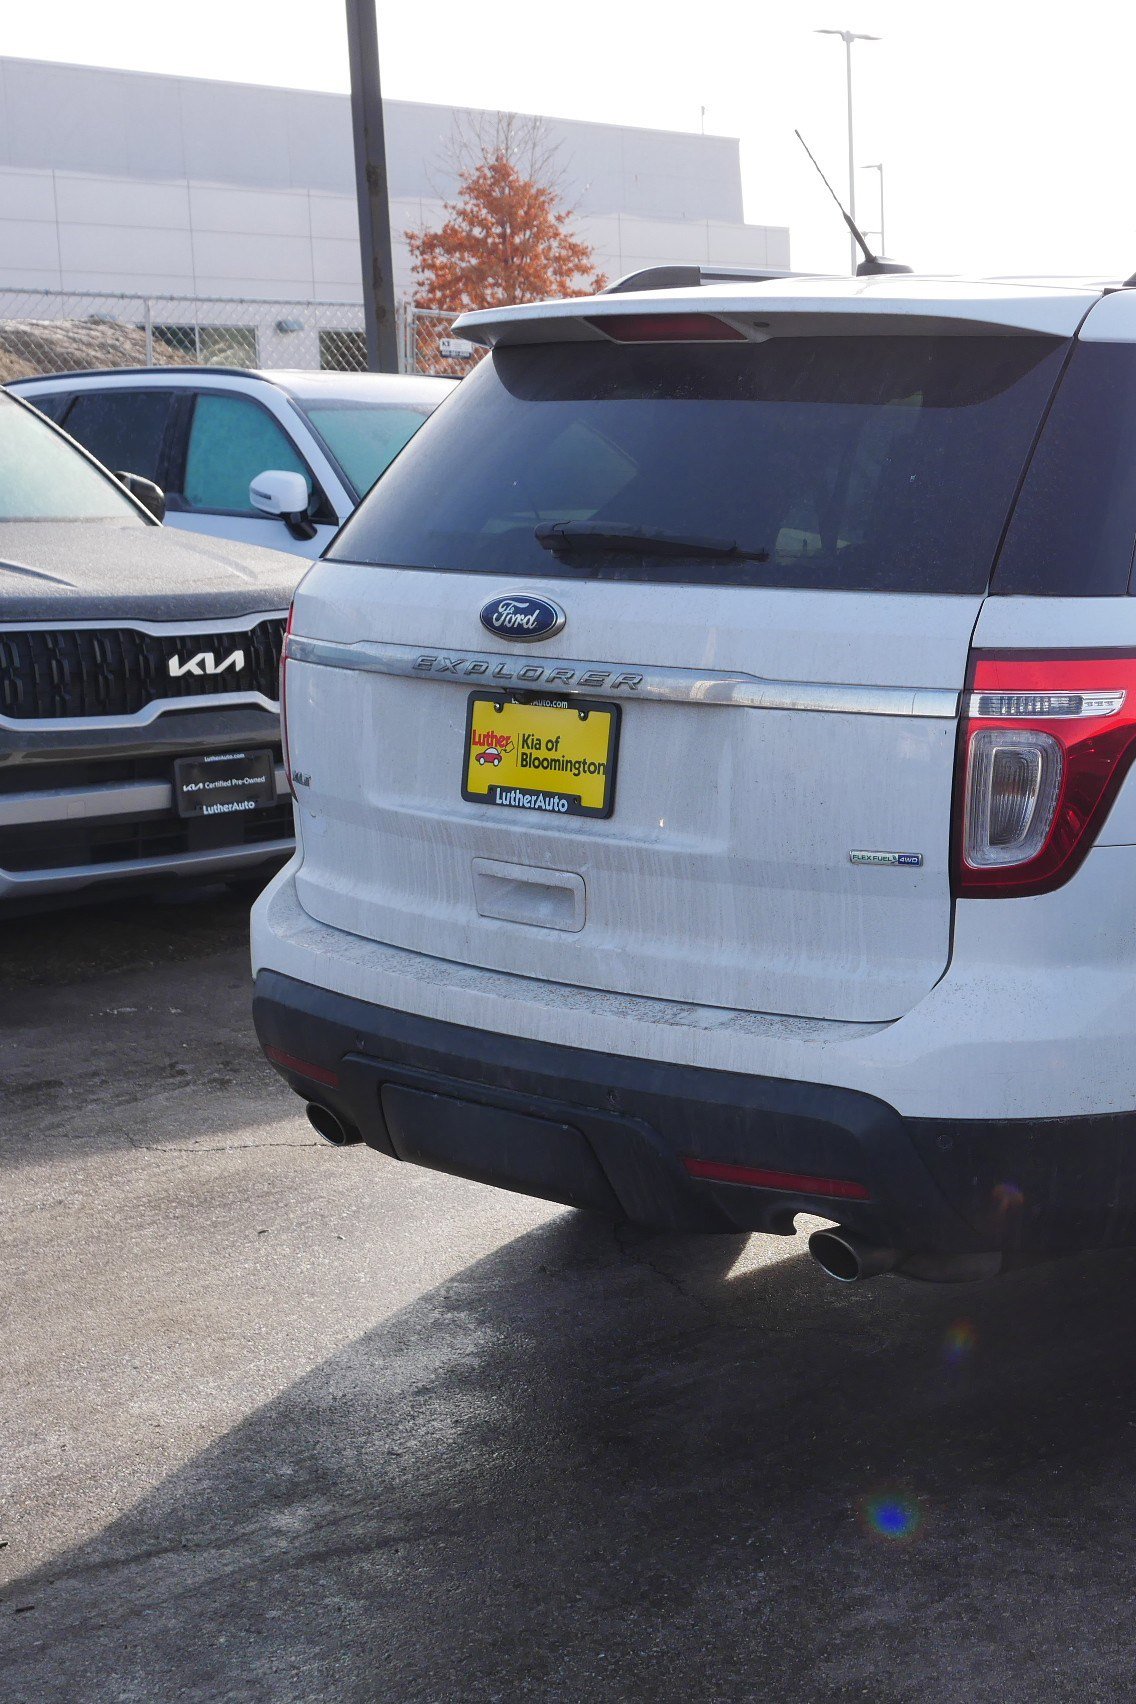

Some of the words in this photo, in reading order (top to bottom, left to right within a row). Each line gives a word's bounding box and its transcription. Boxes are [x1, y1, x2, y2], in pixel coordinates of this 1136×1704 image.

[492, 600, 540, 629] Ford
[168, 650, 245, 677] KIA
[412, 655, 643, 690] EXPLORER
[472, 729, 511, 748] Luther
[521, 733, 542, 750] Kia
[545, 735, 560, 752] of
[204, 753, 245, 762] LutherAuto.com
[520, 752, 606, 777] Bloomington
[183, 782, 203, 792] KIA
[205, 780, 231, 789] Certified
[232, 775, 266, 786] Pre-Owned
[203, 800, 255, 815] LutherAuto
[495, 787, 568, 812] LutherAuto
